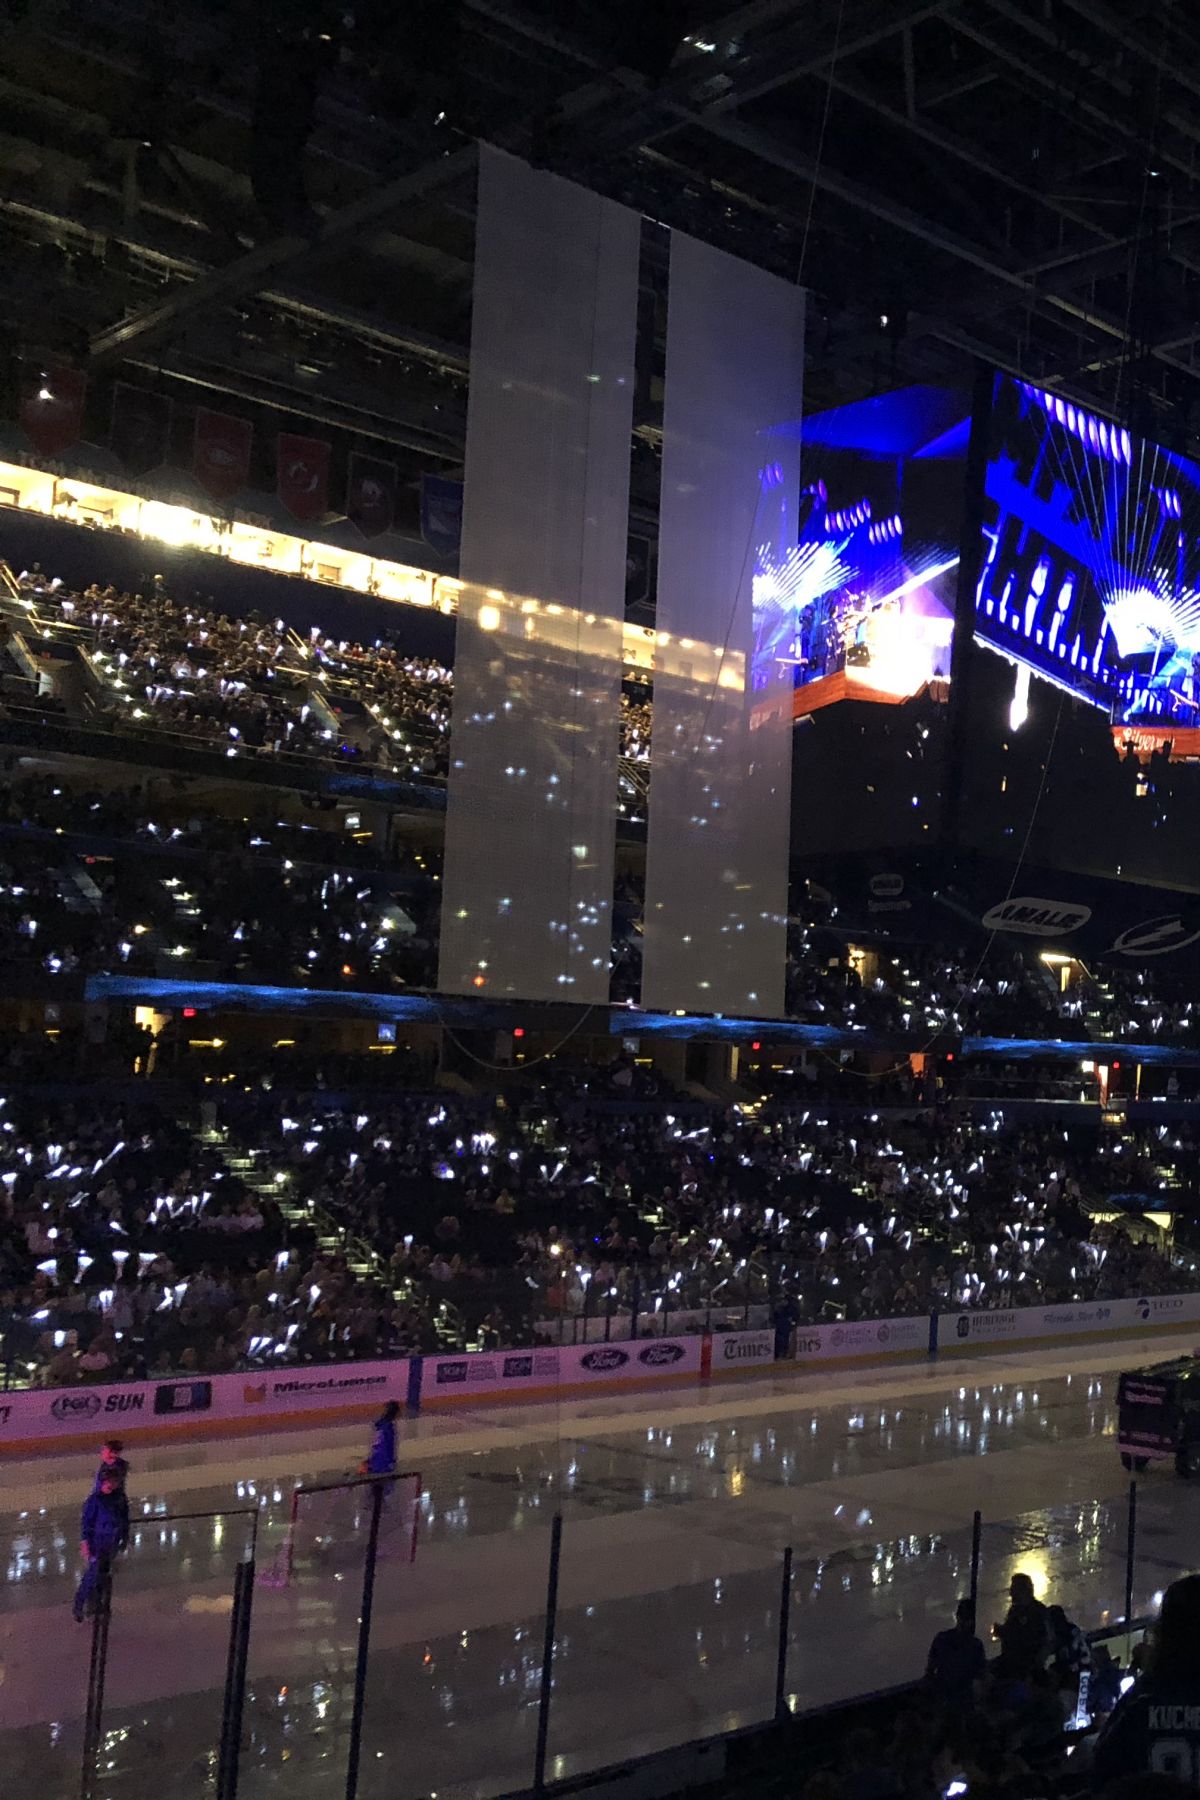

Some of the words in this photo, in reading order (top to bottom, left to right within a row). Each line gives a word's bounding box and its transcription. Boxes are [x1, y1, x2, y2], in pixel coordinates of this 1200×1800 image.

[989, 904, 1084, 929] AMALIE
[586, 1350, 624, 1368] Ford
[644, 1346, 680, 1364] Ford
[724, 1338, 771, 1360] Times
[105, 1392, 145, 1412] SUN
